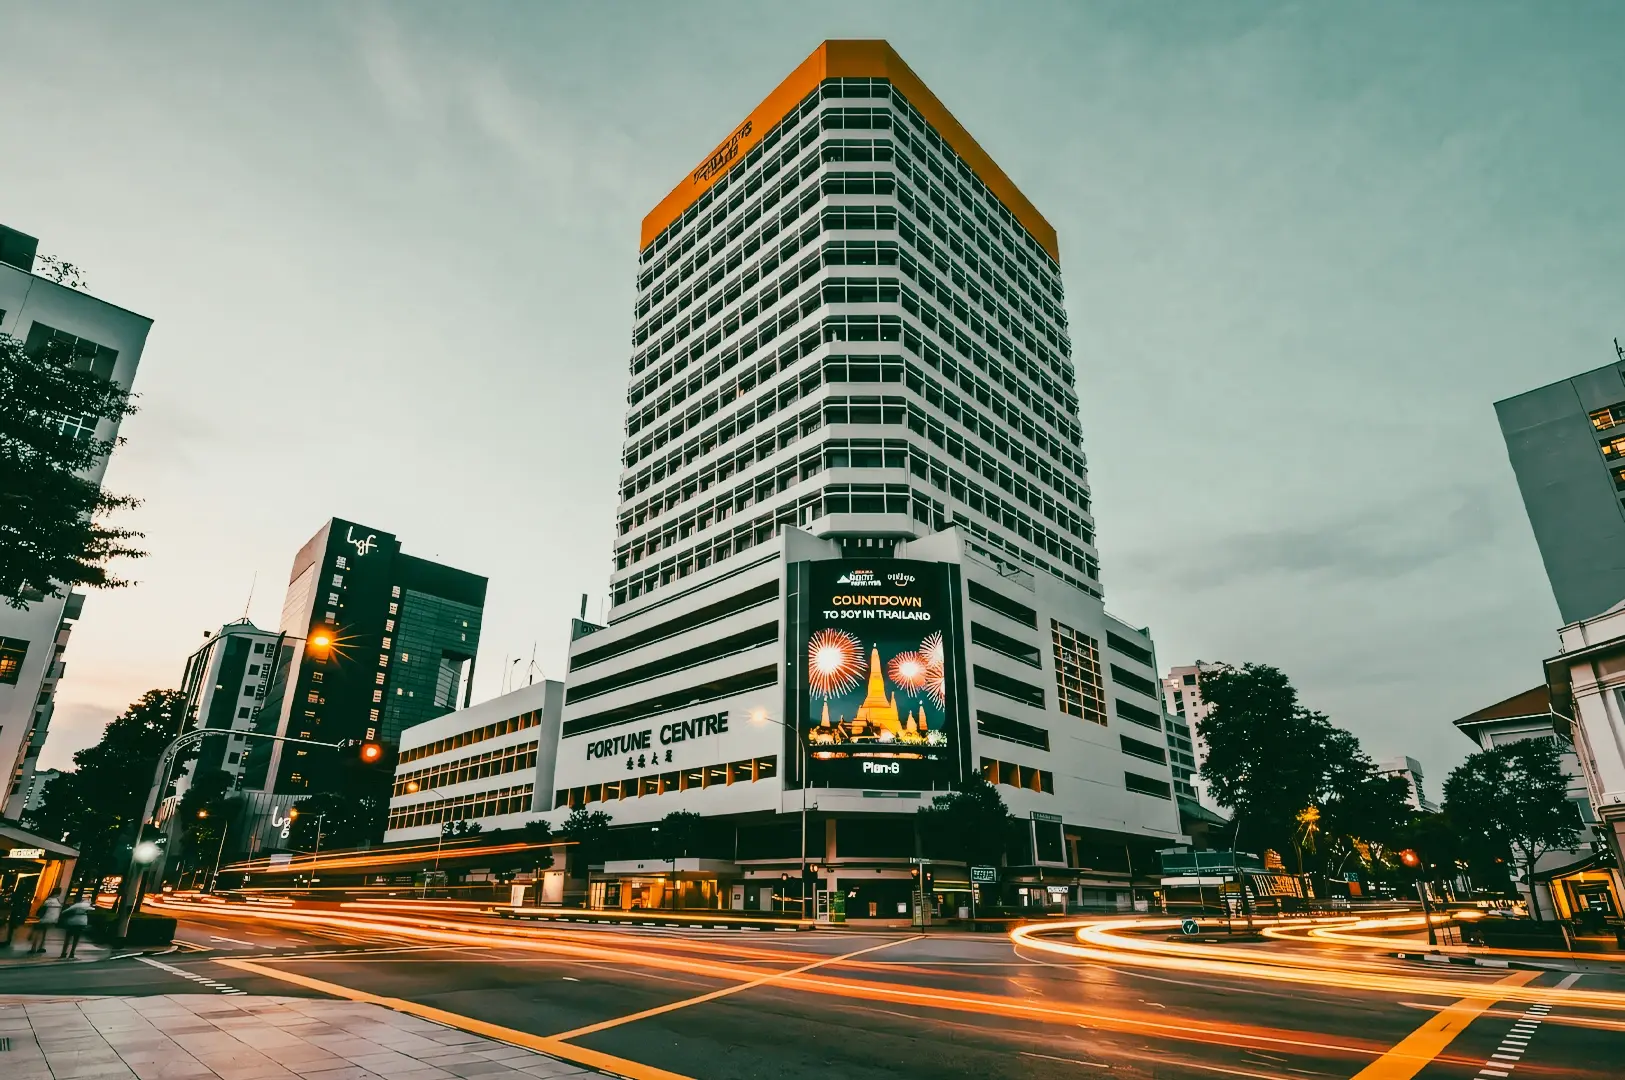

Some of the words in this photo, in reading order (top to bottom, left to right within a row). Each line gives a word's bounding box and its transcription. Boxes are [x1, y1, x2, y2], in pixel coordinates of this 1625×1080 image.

[832, 595, 922, 608] COUNTDOWN
[823, 610, 839, 619] TO
[862, 609, 875, 619] IN
[876, 609, 931, 621] THAILAND
[586, 729, 652, 761] FORTUNE
[660, 711, 729, 746] CENTRE
